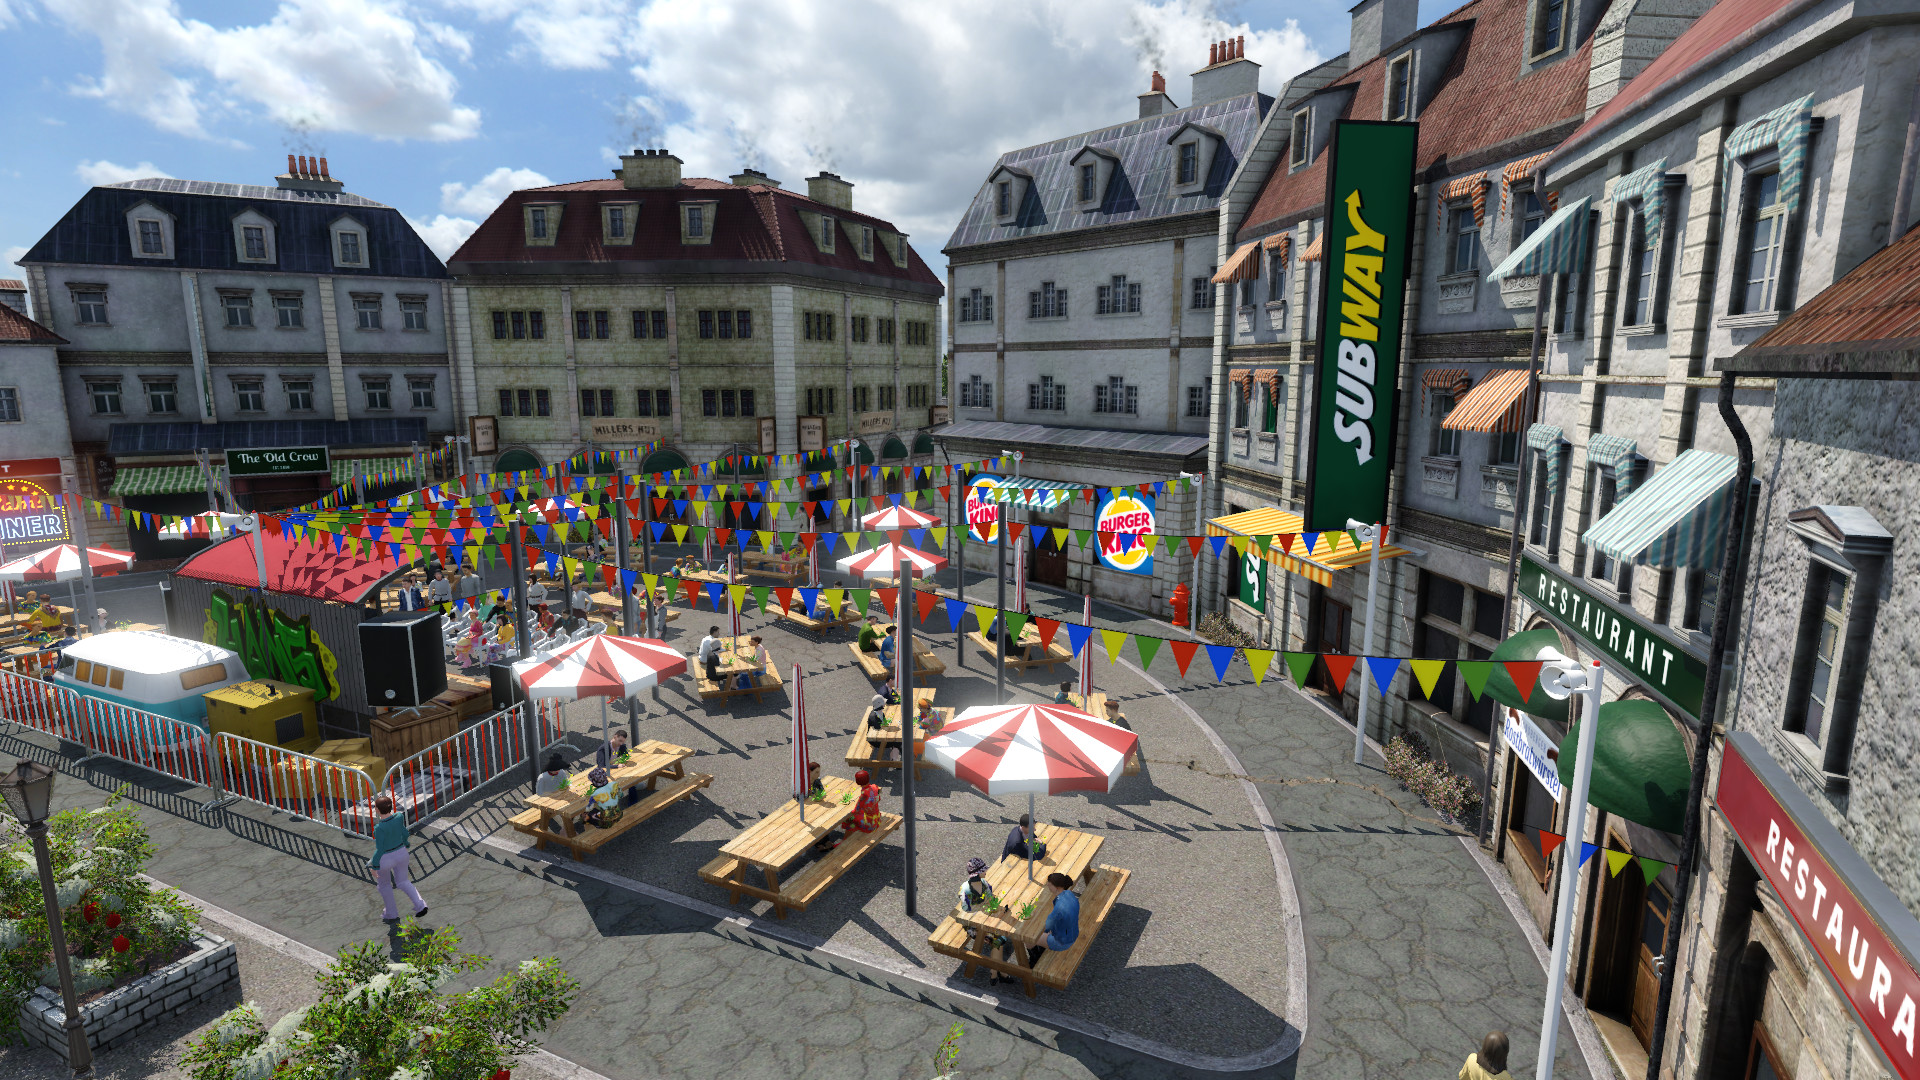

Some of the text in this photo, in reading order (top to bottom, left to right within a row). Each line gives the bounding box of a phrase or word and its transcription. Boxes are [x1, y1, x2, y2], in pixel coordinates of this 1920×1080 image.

[1333, 189, 1386, 466] SUBWAY
[594, 424, 634, 435] MILLERS
[237, 451, 319, 464] The Old Crow
[1100, 512, 1151, 534] BURGER
[1537, 572, 1675, 687] RESTAURANT
